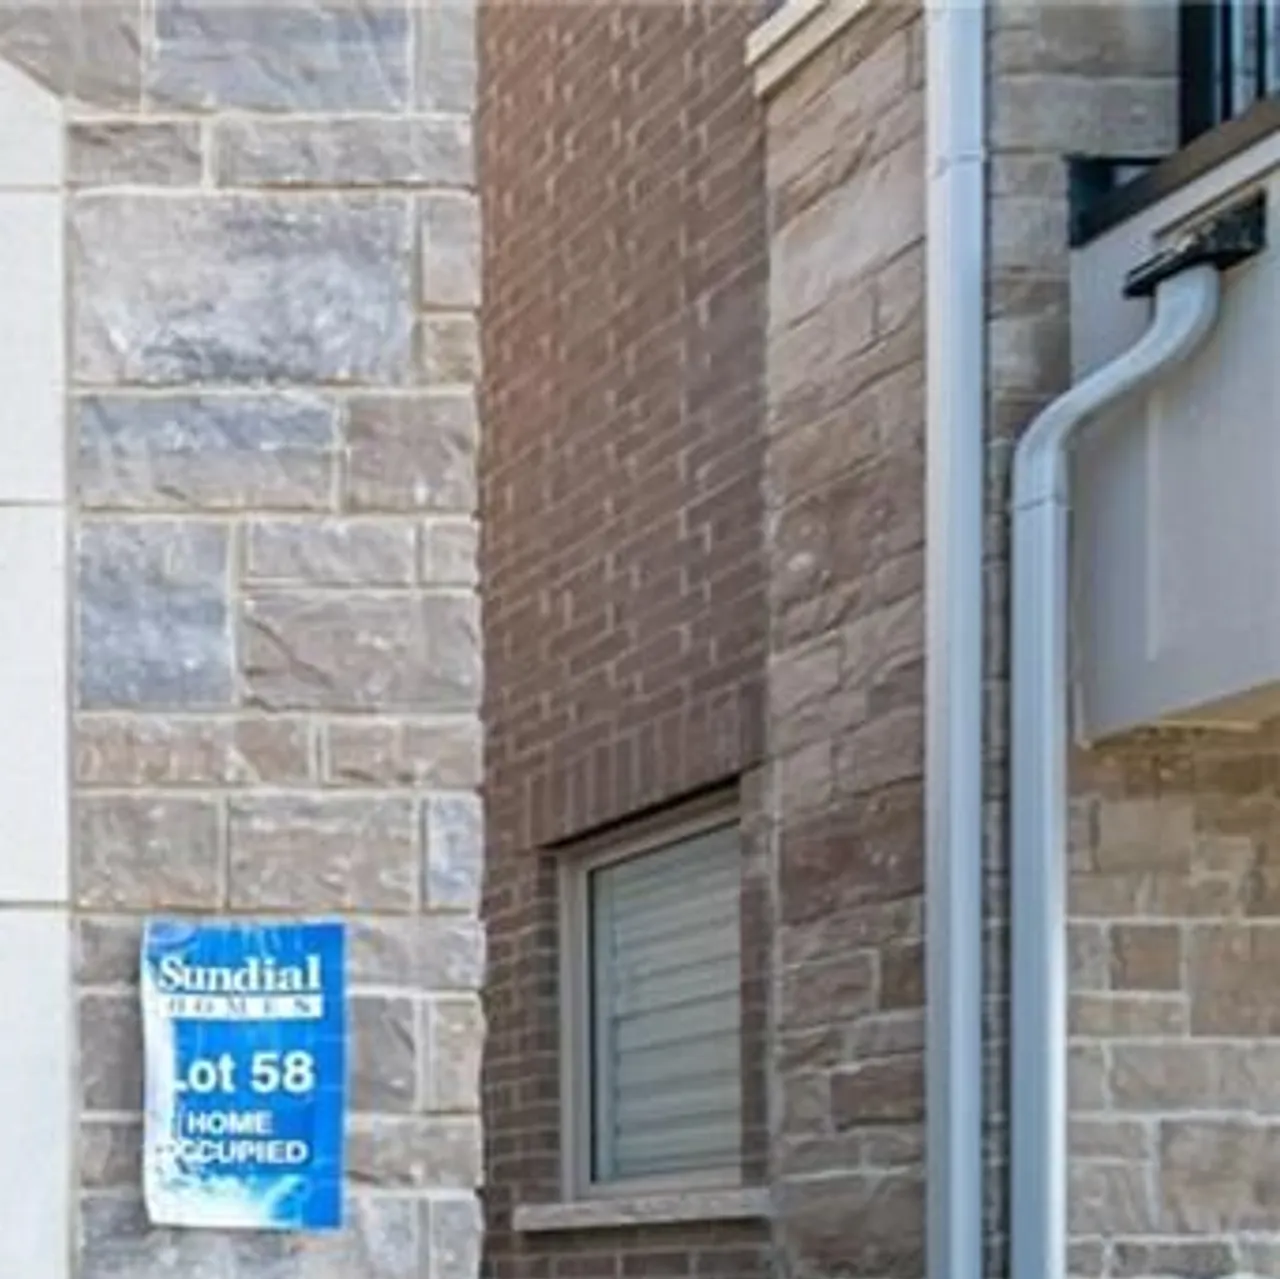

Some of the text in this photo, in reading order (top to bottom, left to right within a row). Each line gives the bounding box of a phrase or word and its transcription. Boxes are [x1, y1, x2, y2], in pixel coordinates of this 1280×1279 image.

[159, 954, 322, 992] Sundial
[251, 1050, 315, 1093] 58
[188, 1110, 274, 1135] HOME
[172, 1139, 309, 1164] CCUPIED
